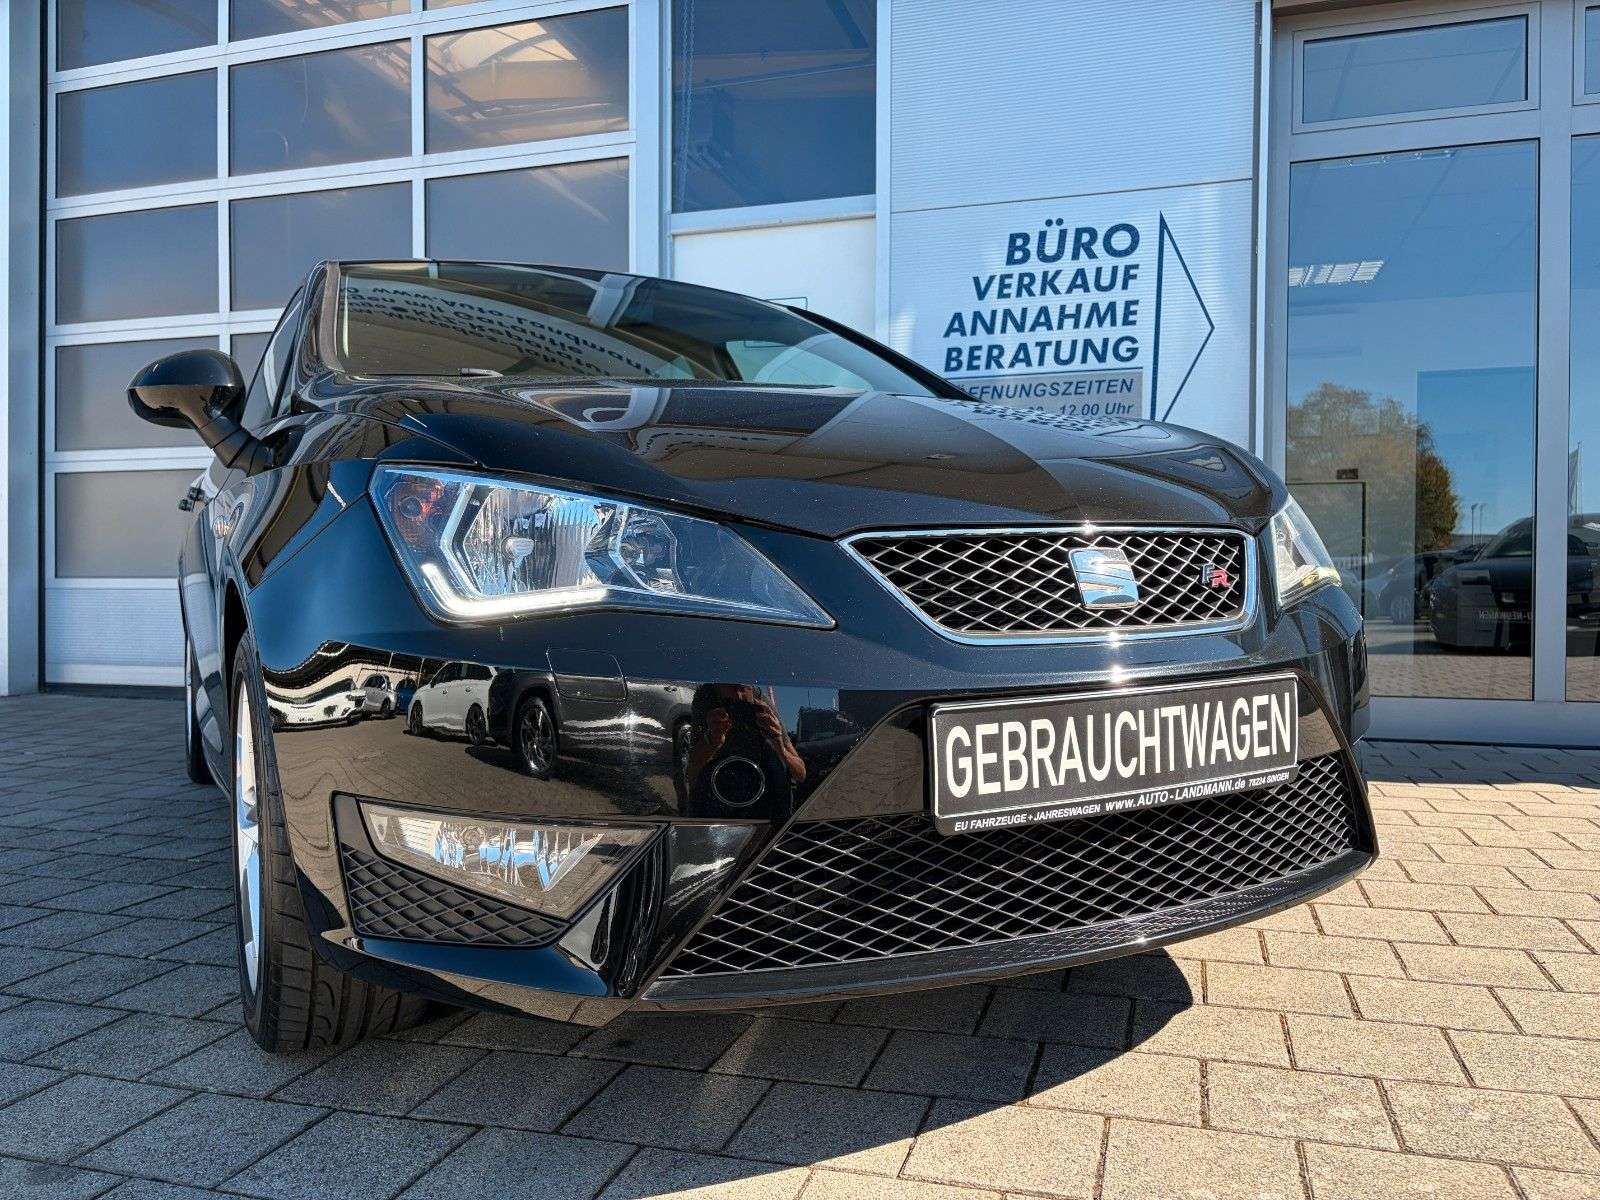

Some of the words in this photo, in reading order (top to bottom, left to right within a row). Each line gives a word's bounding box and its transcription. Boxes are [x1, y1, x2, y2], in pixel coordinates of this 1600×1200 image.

[1006, 218, 1140, 266] BÜRO
[972, 264, 1140, 300] VERKAUF
[943, 300, 1140, 338] ANNAHME
[944, 336, 1139, 372] BERATUNG
[1104, 402, 1134, 416] Uhr
[946, 692, 1291, 798] GEBRAUCHTWAGEN
[954, 821, 969, 832] EU
